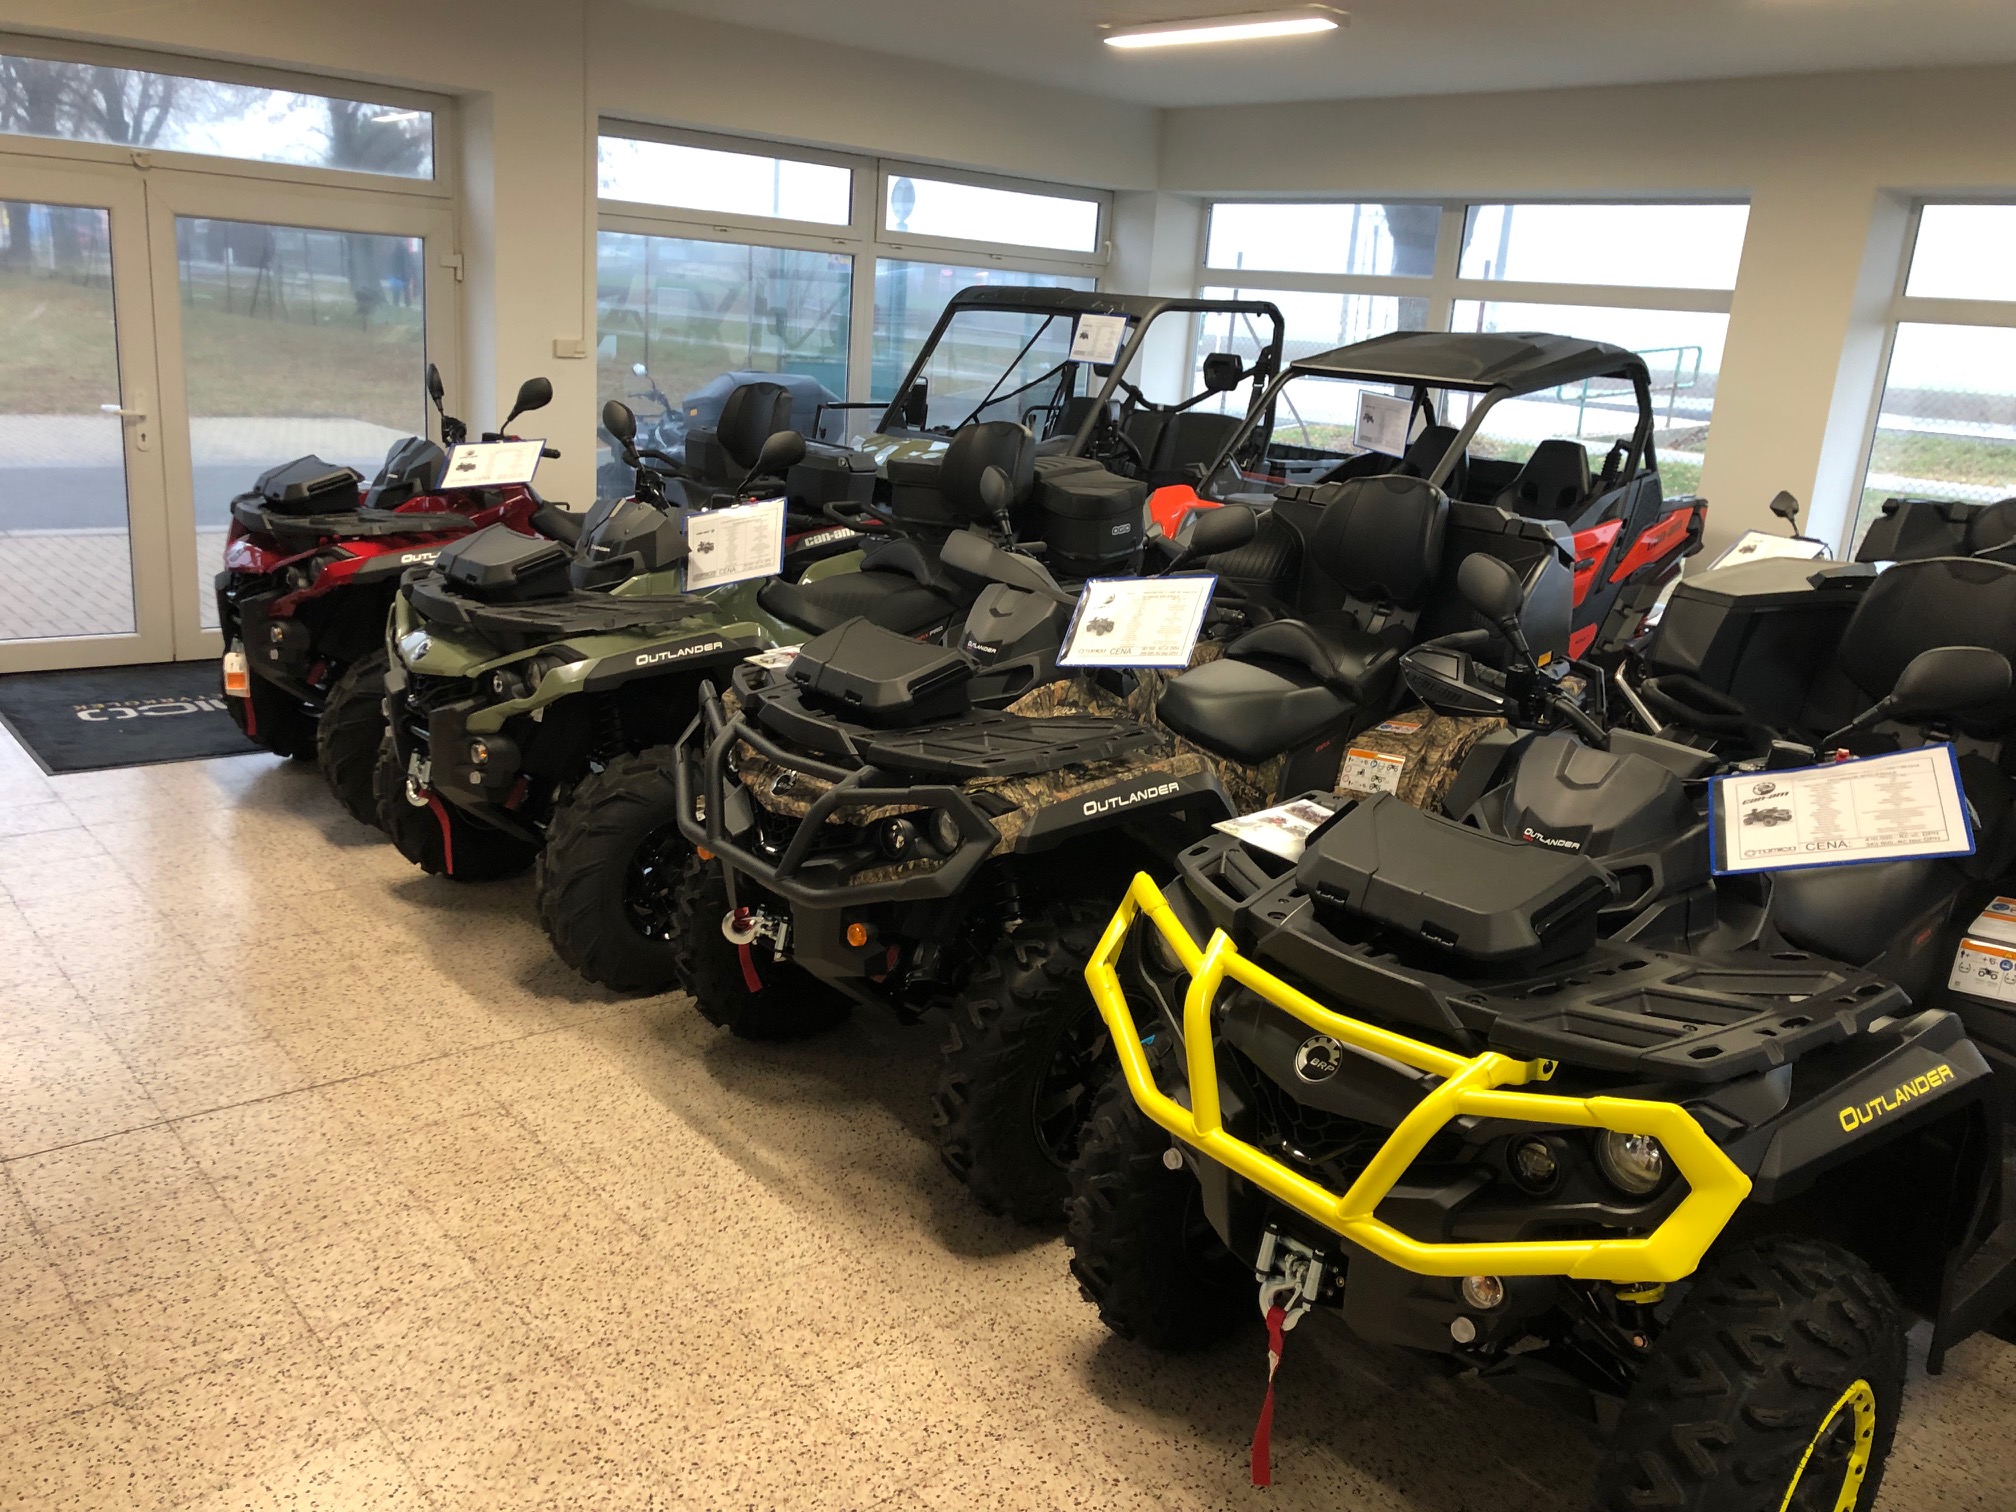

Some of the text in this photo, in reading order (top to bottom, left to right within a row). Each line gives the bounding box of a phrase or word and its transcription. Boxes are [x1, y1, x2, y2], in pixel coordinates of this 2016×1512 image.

[635, 641, 723, 666] OUTLANDER
[1083, 781, 1180, 816] OUTLANDER
[1523, 827, 1581, 850] OUTLANDER
[1309, 1057, 1335, 1072] BRP
[1839, 1064, 1954, 1133] OUTLANDER
